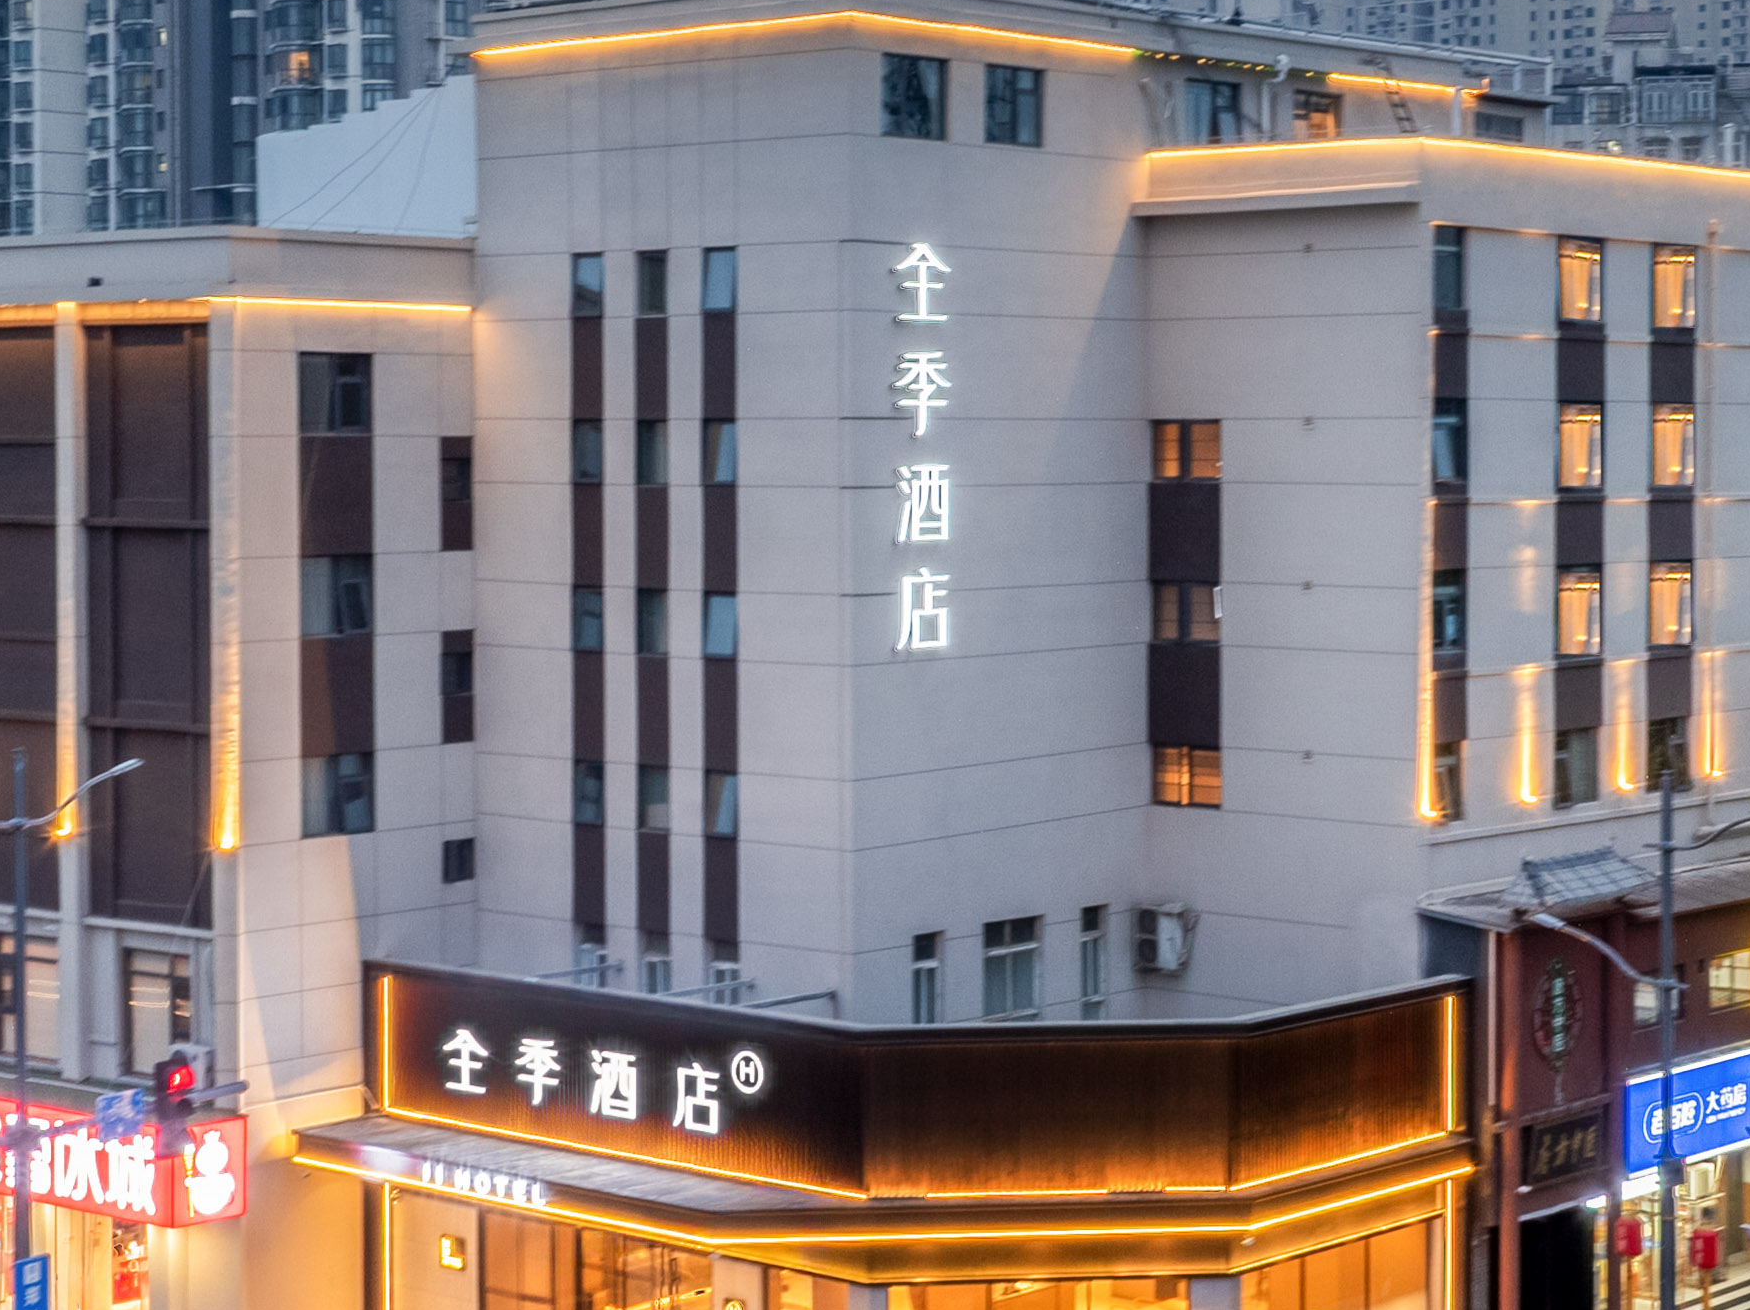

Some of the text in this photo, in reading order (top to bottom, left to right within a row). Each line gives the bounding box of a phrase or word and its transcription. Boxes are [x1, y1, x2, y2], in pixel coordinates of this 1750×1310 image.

[891, 241, 953, 653] 全季酒店
[442, 1028, 722, 1135] 全季酒店
[1705, 1083, 1748, 1115] 大药房
[454, 1167, 546, 1208] HOTEL
